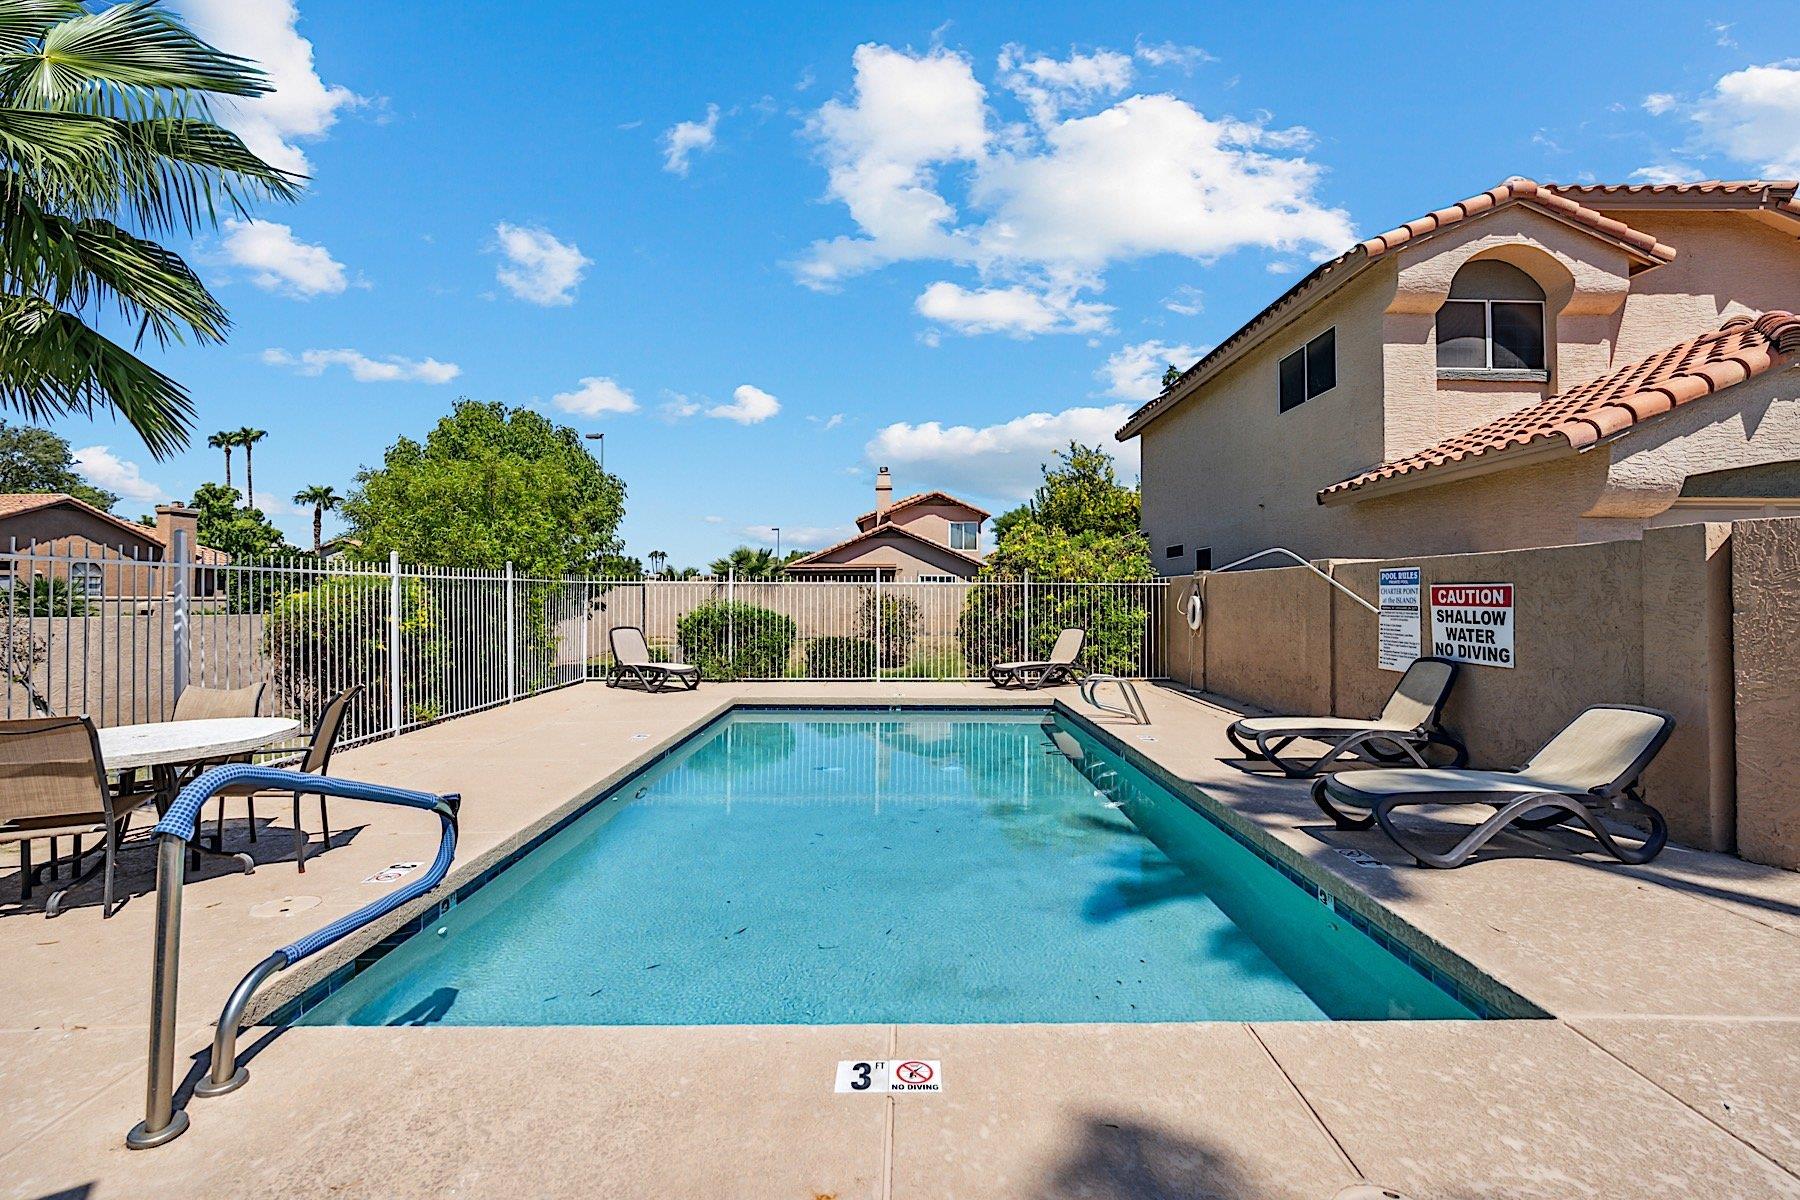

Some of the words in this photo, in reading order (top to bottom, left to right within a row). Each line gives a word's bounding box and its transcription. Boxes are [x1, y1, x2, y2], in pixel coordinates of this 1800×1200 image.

[1381, 572, 1397, 580] POOL
[1398, 571, 1418, 580] RULES
[1381, 587, 1402, 595] CHARTER
[1403, 587, 1418, 595] POINT
[1438, 589, 1504, 604] CAUTION
[1436, 609, 1506, 626] SHALLOW
[1445, 626, 1496, 644] WATER
[1435, 642, 1454, 656] NO
[1458, 644, 1510, 663] DIVING
[851, 1062, 872, 1090] 3
[875, 1062, 885, 1070] FT
